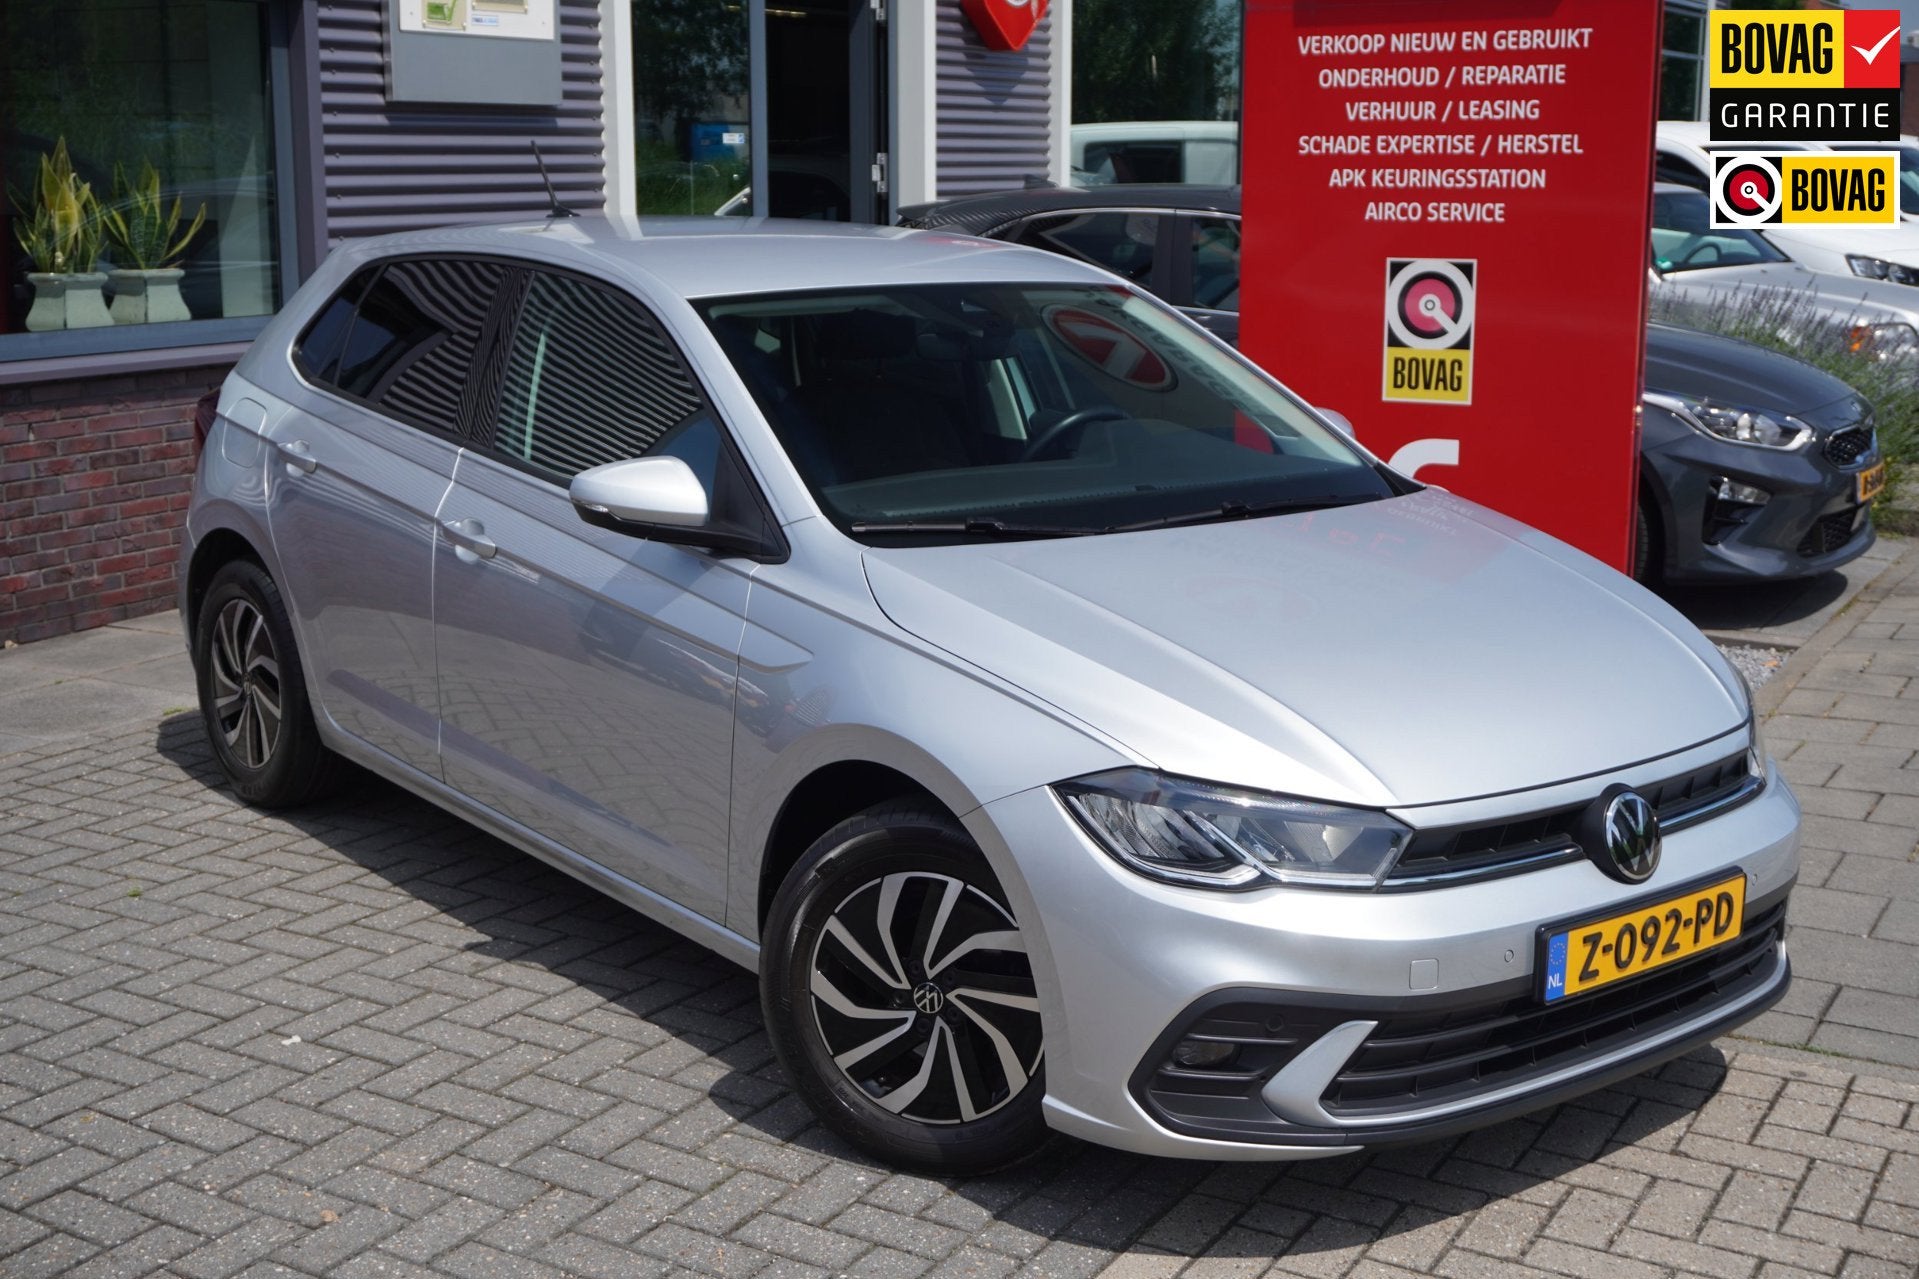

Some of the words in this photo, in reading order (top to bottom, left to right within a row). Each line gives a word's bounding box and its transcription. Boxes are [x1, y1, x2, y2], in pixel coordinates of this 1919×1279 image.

[1298, 33, 1385, 55] VERKOOP
[1390, 31, 1457, 53] NIEUW
[1461, 30, 1487, 51] EN
[1492, 27, 1593, 51] GEBRUIKT
[1318, 66, 1440, 89] ONDERHOUD
[1444, 66, 1456, 89] /
[1461, 63, 1566, 86] REPARATIE
[1345, 100, 1437, 121] VERHUUR
[1441, 100, 1453, 123] /
[1458, 99, 1540, 120] LEASING
[1298, 134, 1371, 155] SCHADE
[1376, 134, 1476, 155] EXPERTISE
[1480, 134, 1492, 157] /
[1497, 133, 1584, 154] HERSTEL
[1328, 168, 1366, 188] APK
[1371, 168, 1546, 189] KEURINGSSTATION
[1364, 201, 1422, 222] AIRCO
[1427, 201, 1506, 223] SERVICE
[1392, 356, 1463, 392] BOVAG
[1547, 973, 1563, 990] NL
[1578, 891, 1734, 985] Z-092-PD
